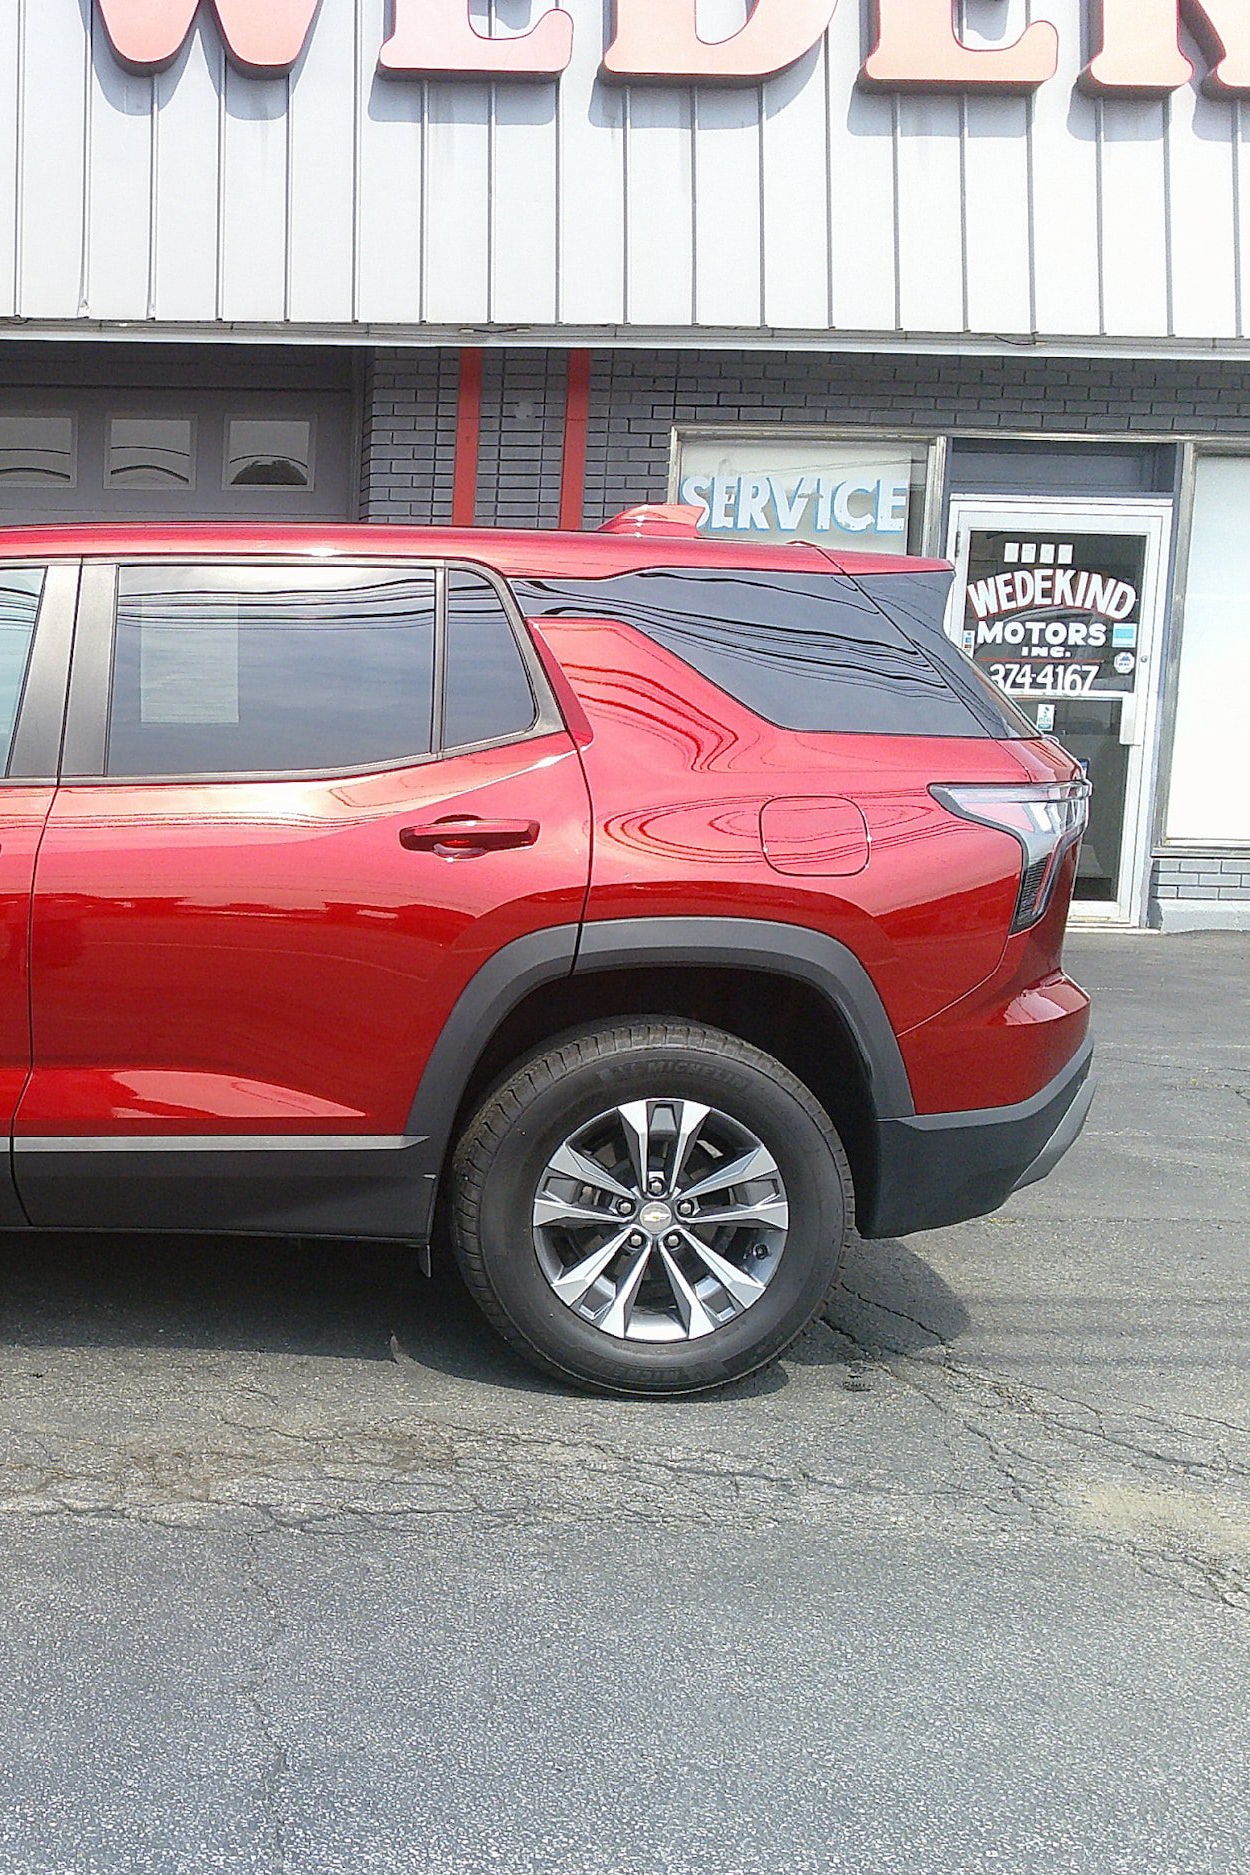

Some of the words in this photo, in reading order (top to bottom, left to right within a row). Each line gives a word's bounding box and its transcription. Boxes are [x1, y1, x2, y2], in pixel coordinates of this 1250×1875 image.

[681, 477, 910, 533] SERVICE
[967, 568, 1136, 619] WEDEKIND
[976, 620, 1108, 647] MOTORS
[1020, 646, 1072, 658] INC.
[988, 662, 1100, 696] 374-4167
